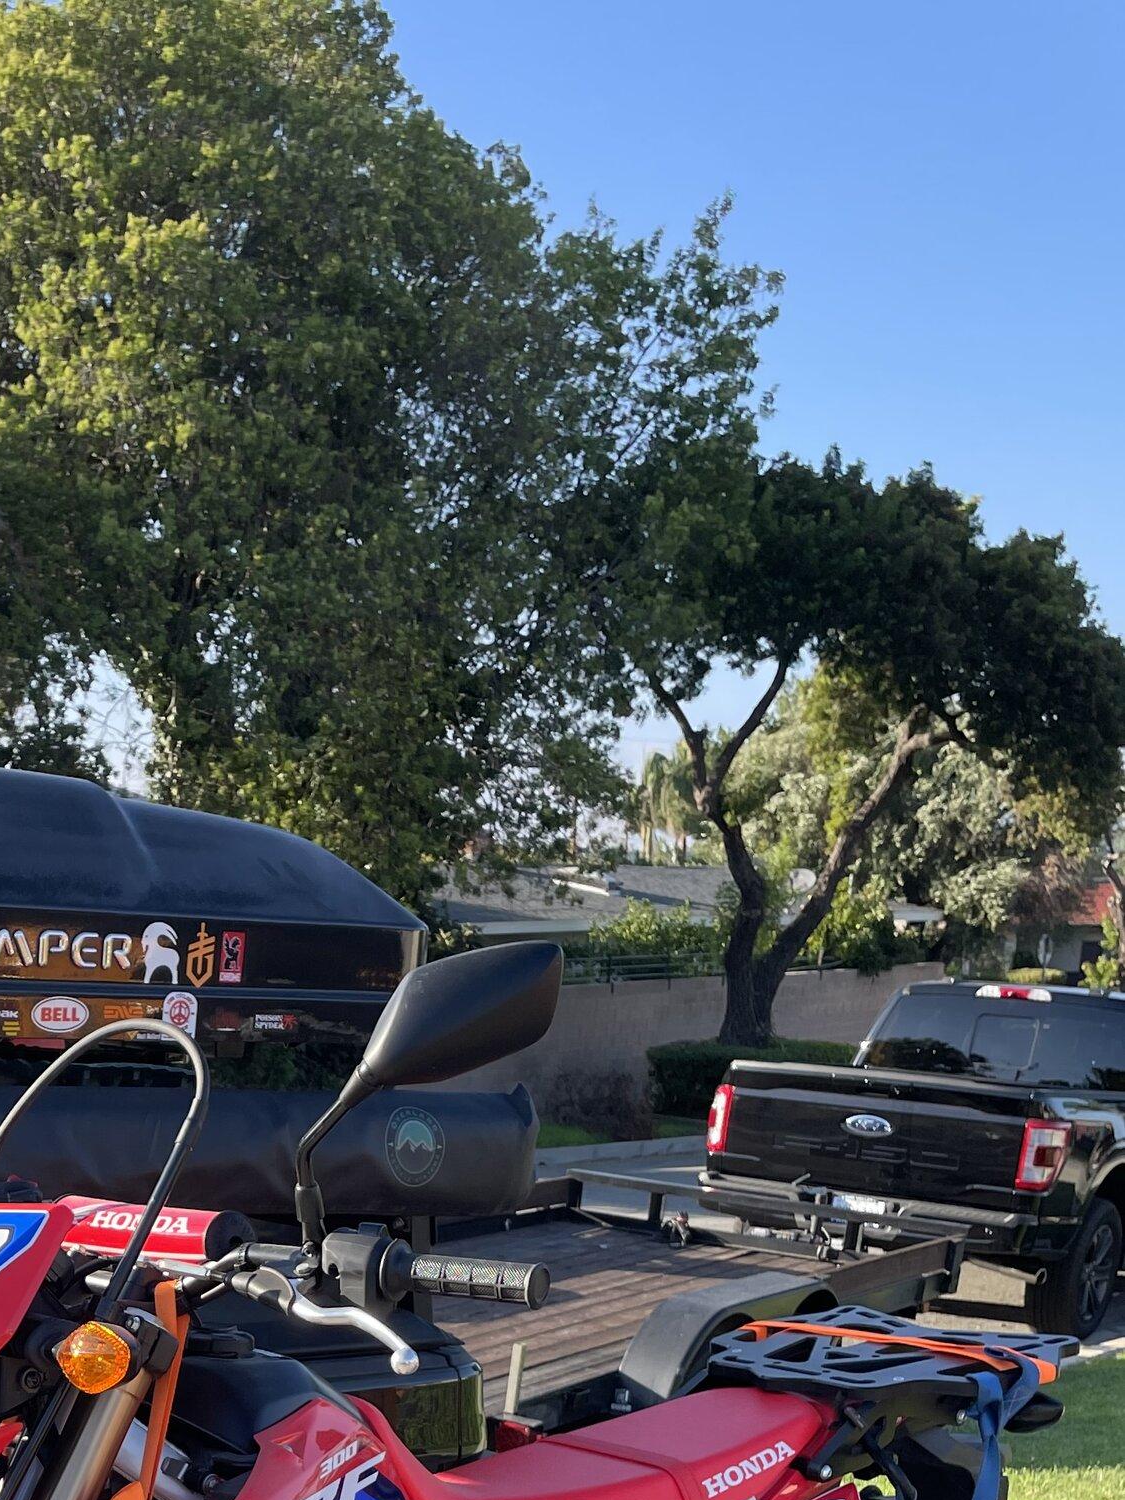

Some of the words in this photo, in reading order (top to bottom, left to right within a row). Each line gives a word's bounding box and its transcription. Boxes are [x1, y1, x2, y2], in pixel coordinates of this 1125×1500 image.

[40, 1007, 80, 1022] BELL
[320, 1441, 359, 1479] 300
[701, 1440, 795, 1498] HONDA
